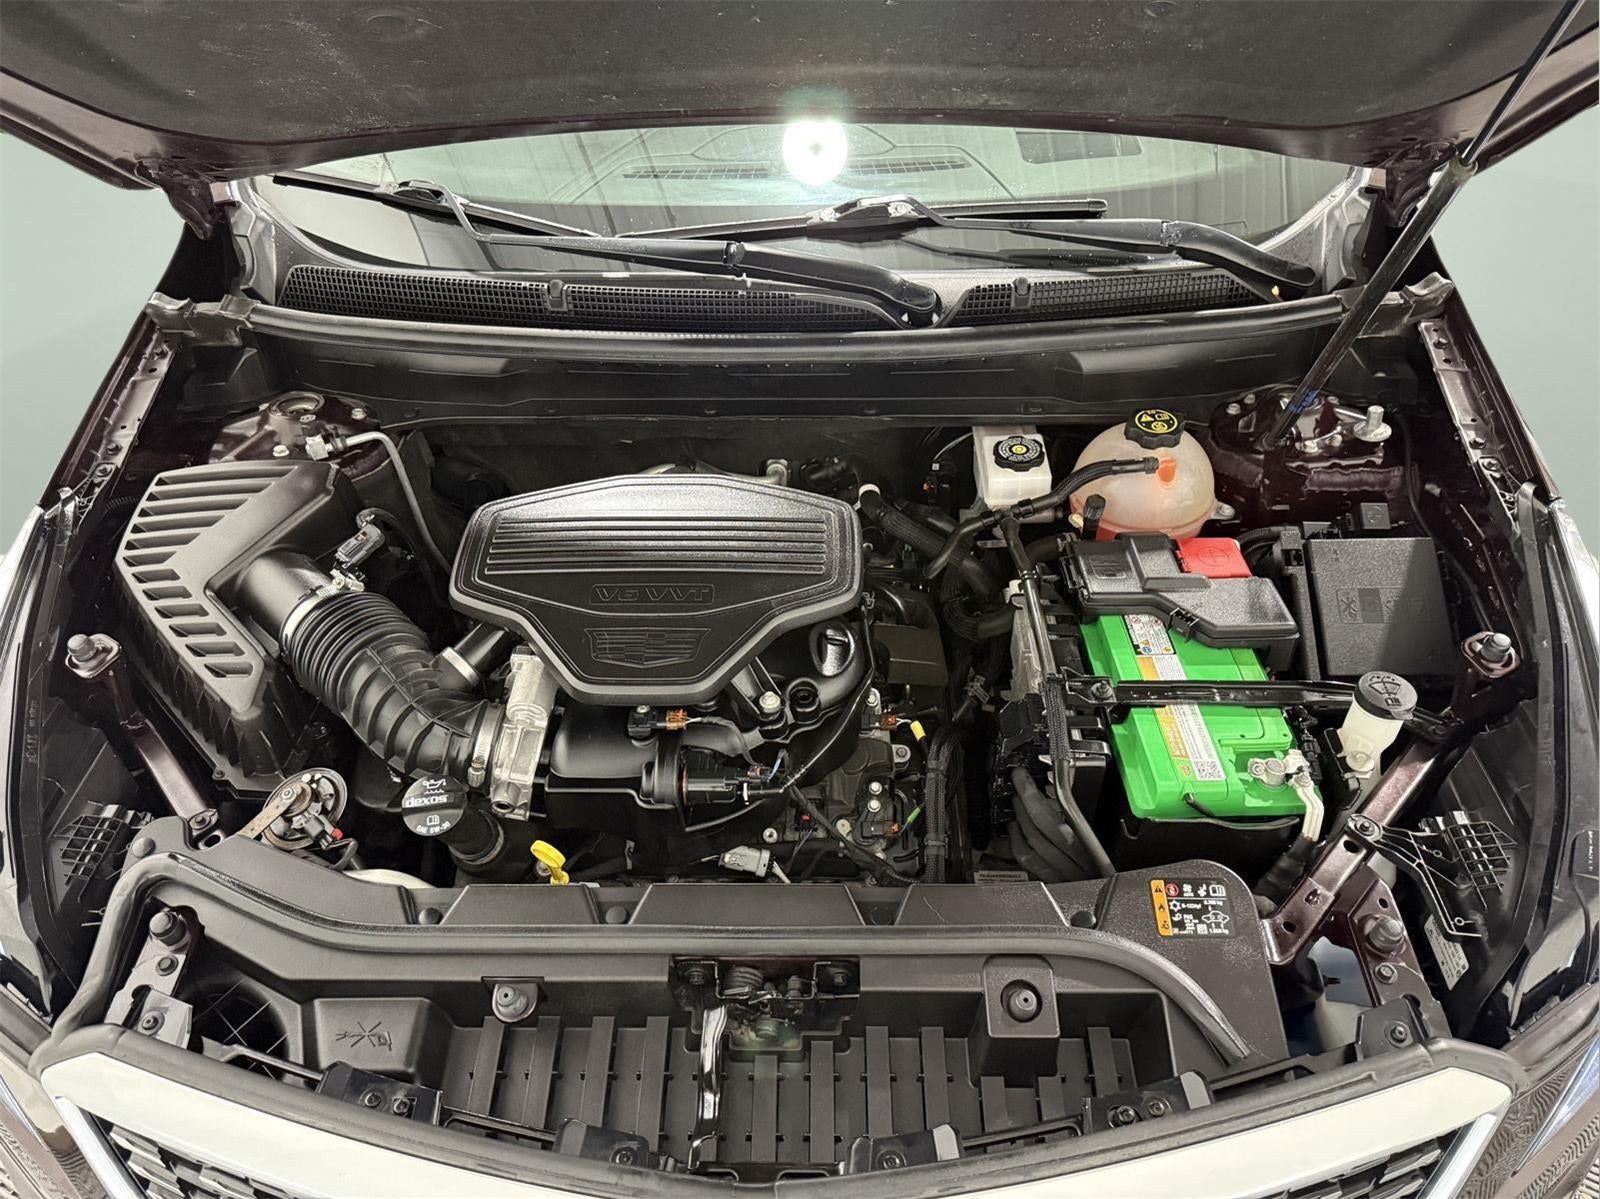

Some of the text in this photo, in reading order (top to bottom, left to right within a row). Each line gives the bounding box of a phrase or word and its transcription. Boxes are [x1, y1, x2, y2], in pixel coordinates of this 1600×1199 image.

[595, 587, 710, 601] V6 VVT
[405, 795, 448, 808] dexos
